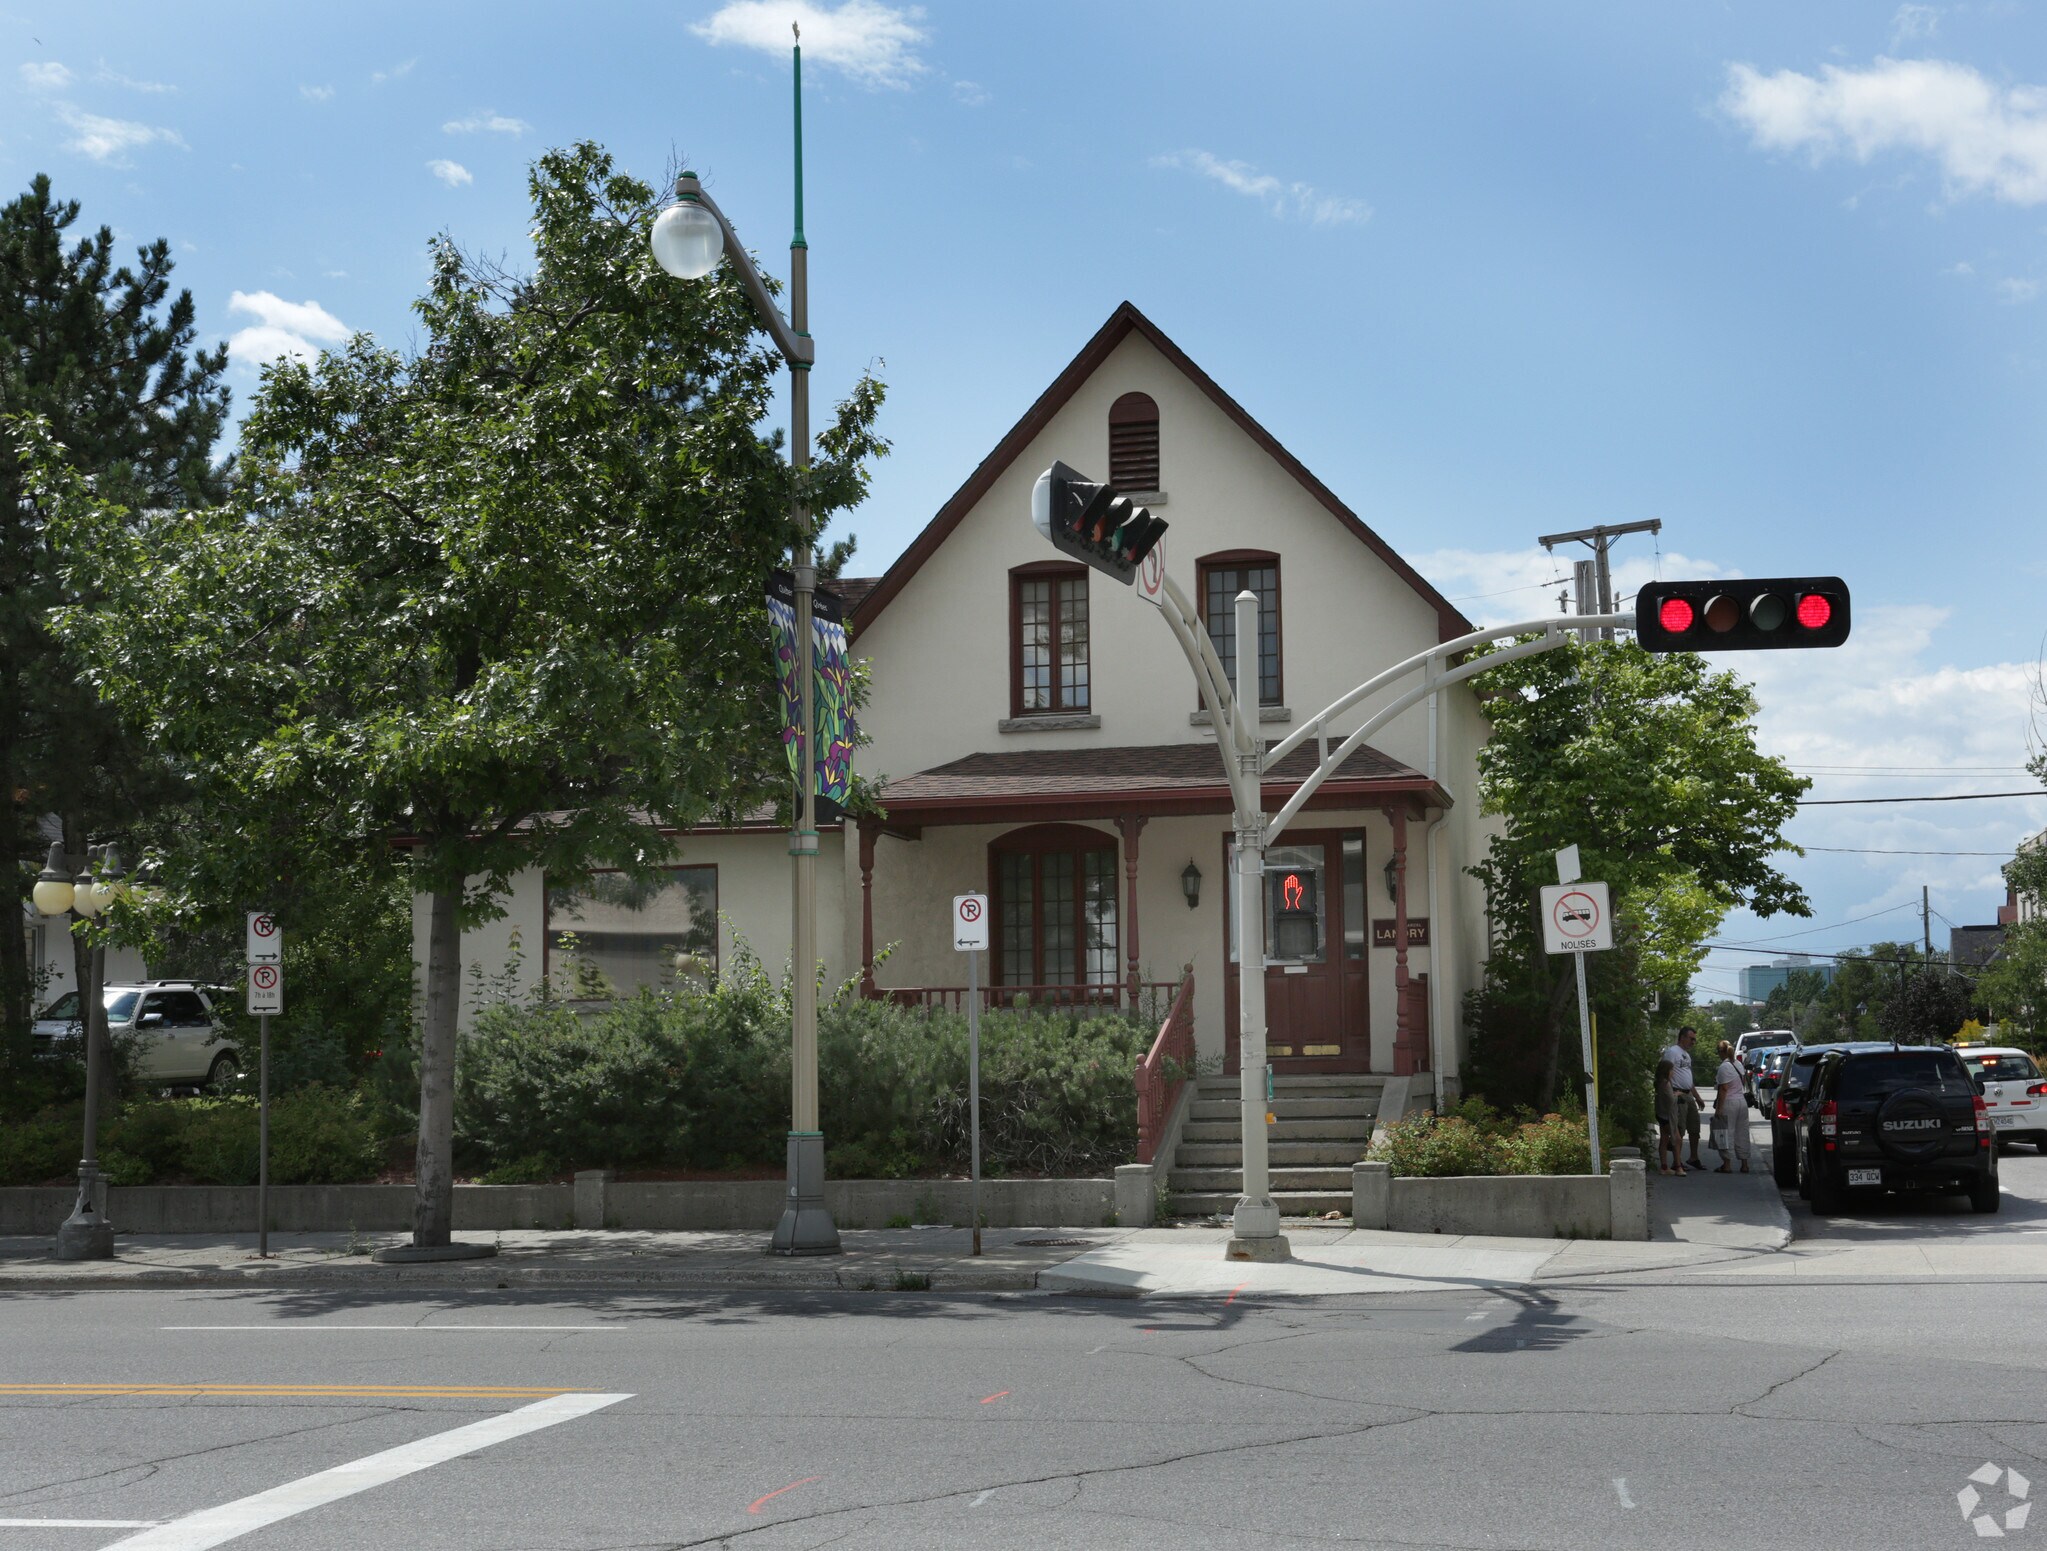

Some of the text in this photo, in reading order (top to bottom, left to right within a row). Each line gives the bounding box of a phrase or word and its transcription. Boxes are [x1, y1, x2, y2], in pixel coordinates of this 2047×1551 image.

[1376, 929, 1425, 939] LANRY
[1883, 1119, 1941, 1131] SUZUKI
[1849, 1172, 1880, 1182] 334 QCW
